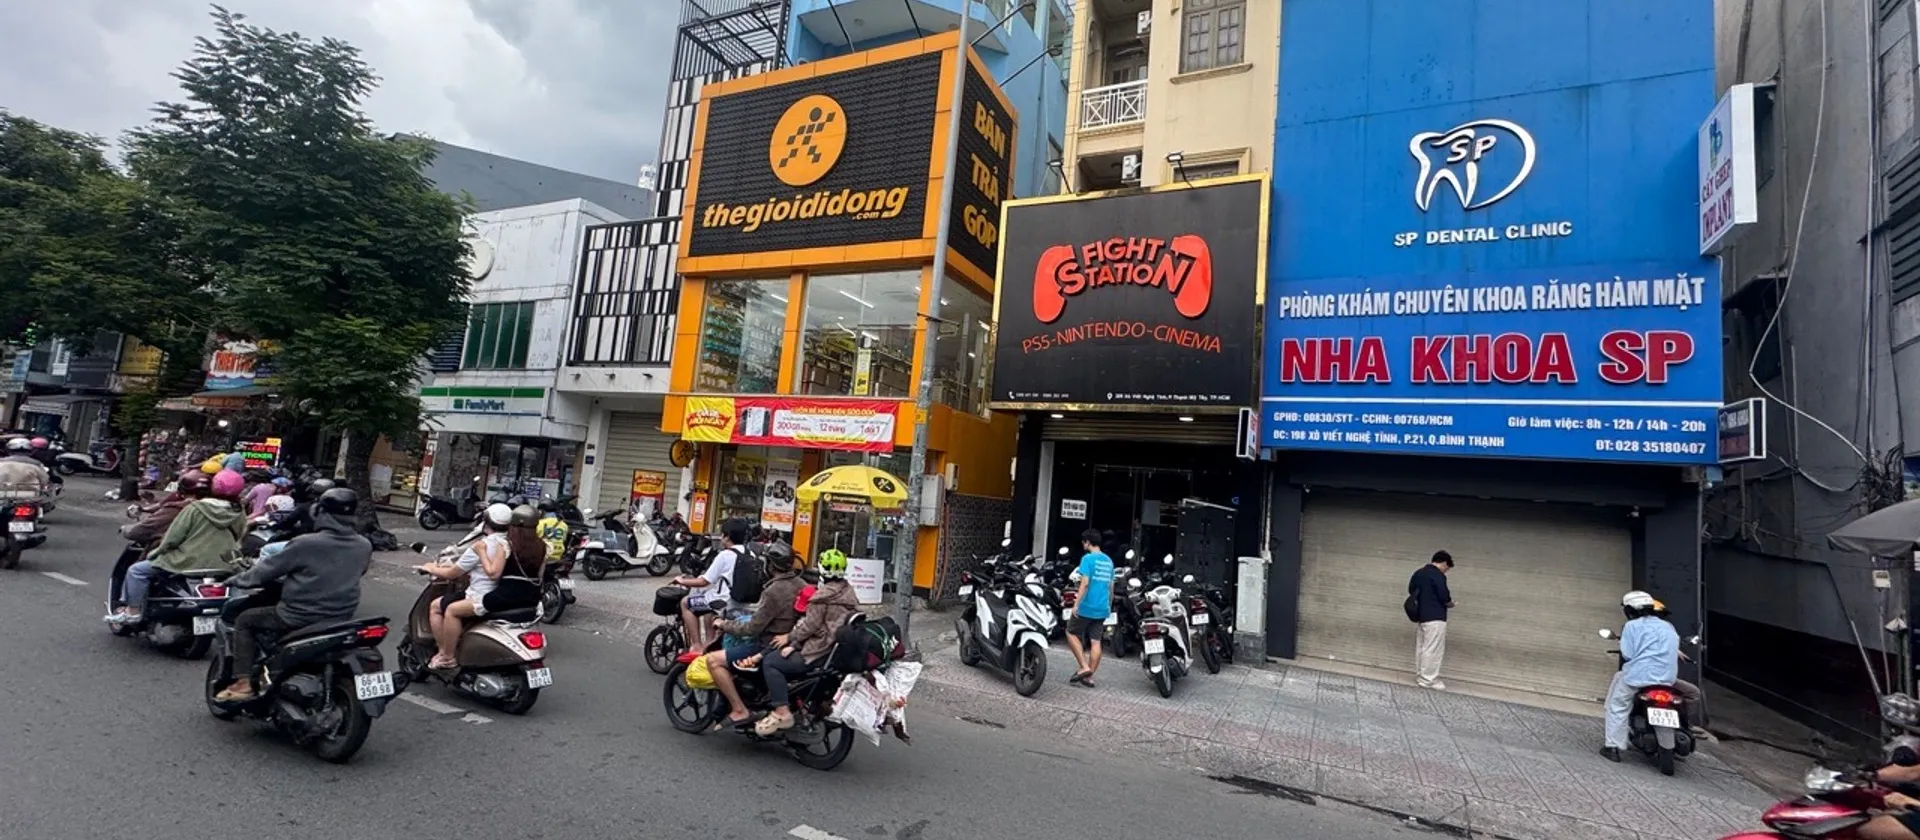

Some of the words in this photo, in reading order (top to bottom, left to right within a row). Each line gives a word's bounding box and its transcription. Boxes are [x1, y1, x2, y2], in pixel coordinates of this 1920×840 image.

[974, 101, 1006, 159] BÁN
[1446, 132, 1497, 163] SP
[970, 153, 999, 208] TRẢ
[702, 185, 909, 232] thegioididong
[962, 203, 997, 250] GÓP
[1394, 231, 1418, 247] SP
[1426, 227, 1499, 245] DENTAL
[1506, 221, 1573, 240] CLINIC
[1081, 236, 1166, 266] FIGHT
[1058, 253, 1190, 296] STATION
[1279, 289, 1335, 319] PHÒNG
[1338, 284, 1390, 317] KHÁM
[1393, 284, 1470, 316] CHUYÊN
[1473, 286, 1527, 312] KHOA
[1532, 278, 1592, 311] RĂNG
[1596, 275, 1650, 308] HÀM
[1653, 273, 1706, 312] MẶT
[1280, 336, 1391, 384] NHA
[1410, 332, 1579, 385] KHOA
[1598, 330, 1695, 385] SP
[465, 399, 505, 411] FamilyMart
[1303, 413, 1353, 423] 00830/SYT
[1362, 414, 1392, 424] CCHN:
[1394, 415, 1453, 426] 00768/HCM
[1323, 429, 1342, 441] VIẾT
[1345, 430, 1370, 444] NGHỆ
[1468, 436, 1505, 448] THẠNH
[1508, 417, 1526, 428] Giờ
[1530, 416, 1551, 428] làm
[1554, 417, 1583, 431] việc:
[1586, 418, 1601, 429] 8h
[1612, 419, 1634, 430] 12h
[1646, 419, 1667, 431] 14h
[1681, 420, 1706, 432] 20h
[1615, 440, 1640, 452] 028
[1642, 441, 1706, 454] 35180407
